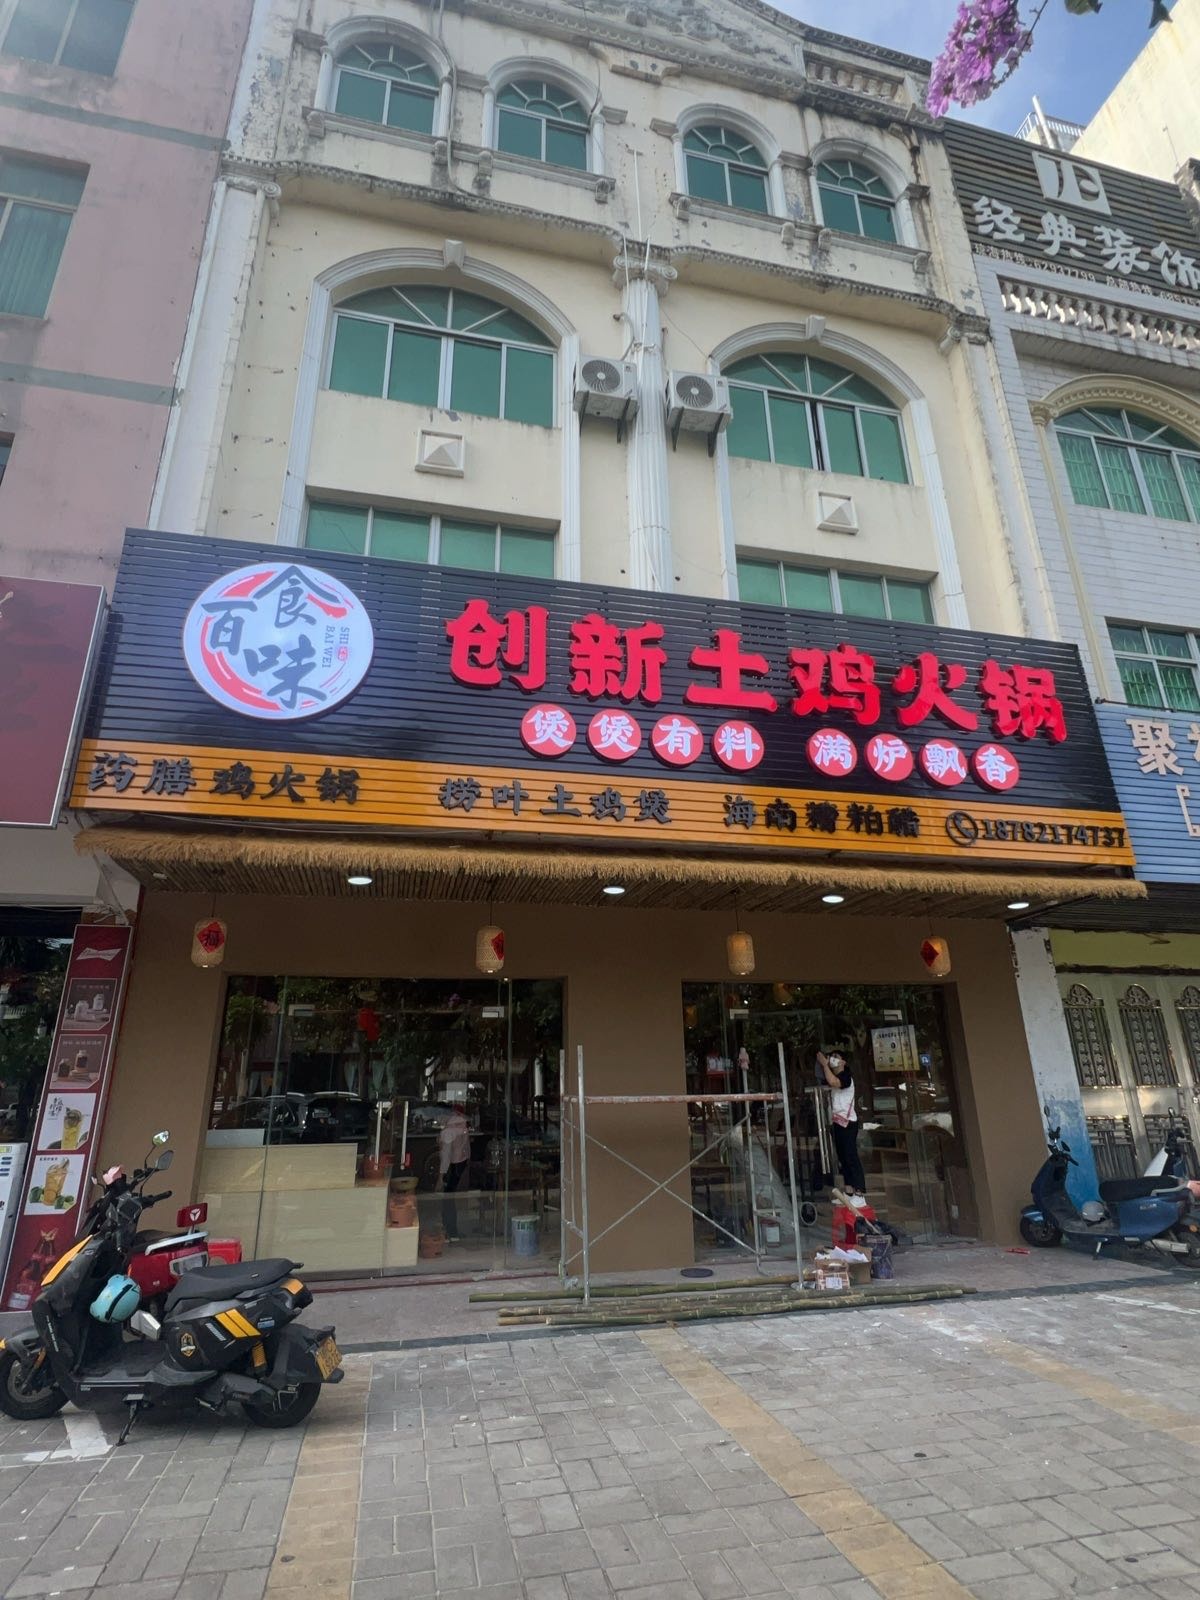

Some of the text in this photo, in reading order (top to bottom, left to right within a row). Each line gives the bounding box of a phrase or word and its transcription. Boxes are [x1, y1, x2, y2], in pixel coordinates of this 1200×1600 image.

[973, 196, 1200, 290] 经典装饰
[339, 626, 350, 645] SHI
[444, 598, 1068, 744] 创新土鸡火锅
[525, 709, 1016, 784] 煲煲有料 满炉飘香
[1126, 718, 1200, 776] 聚
[88, 752, 1125, 848] 药膳鸡火锅 捞叶土鸡煲 海南糟粕醋 18782174737
